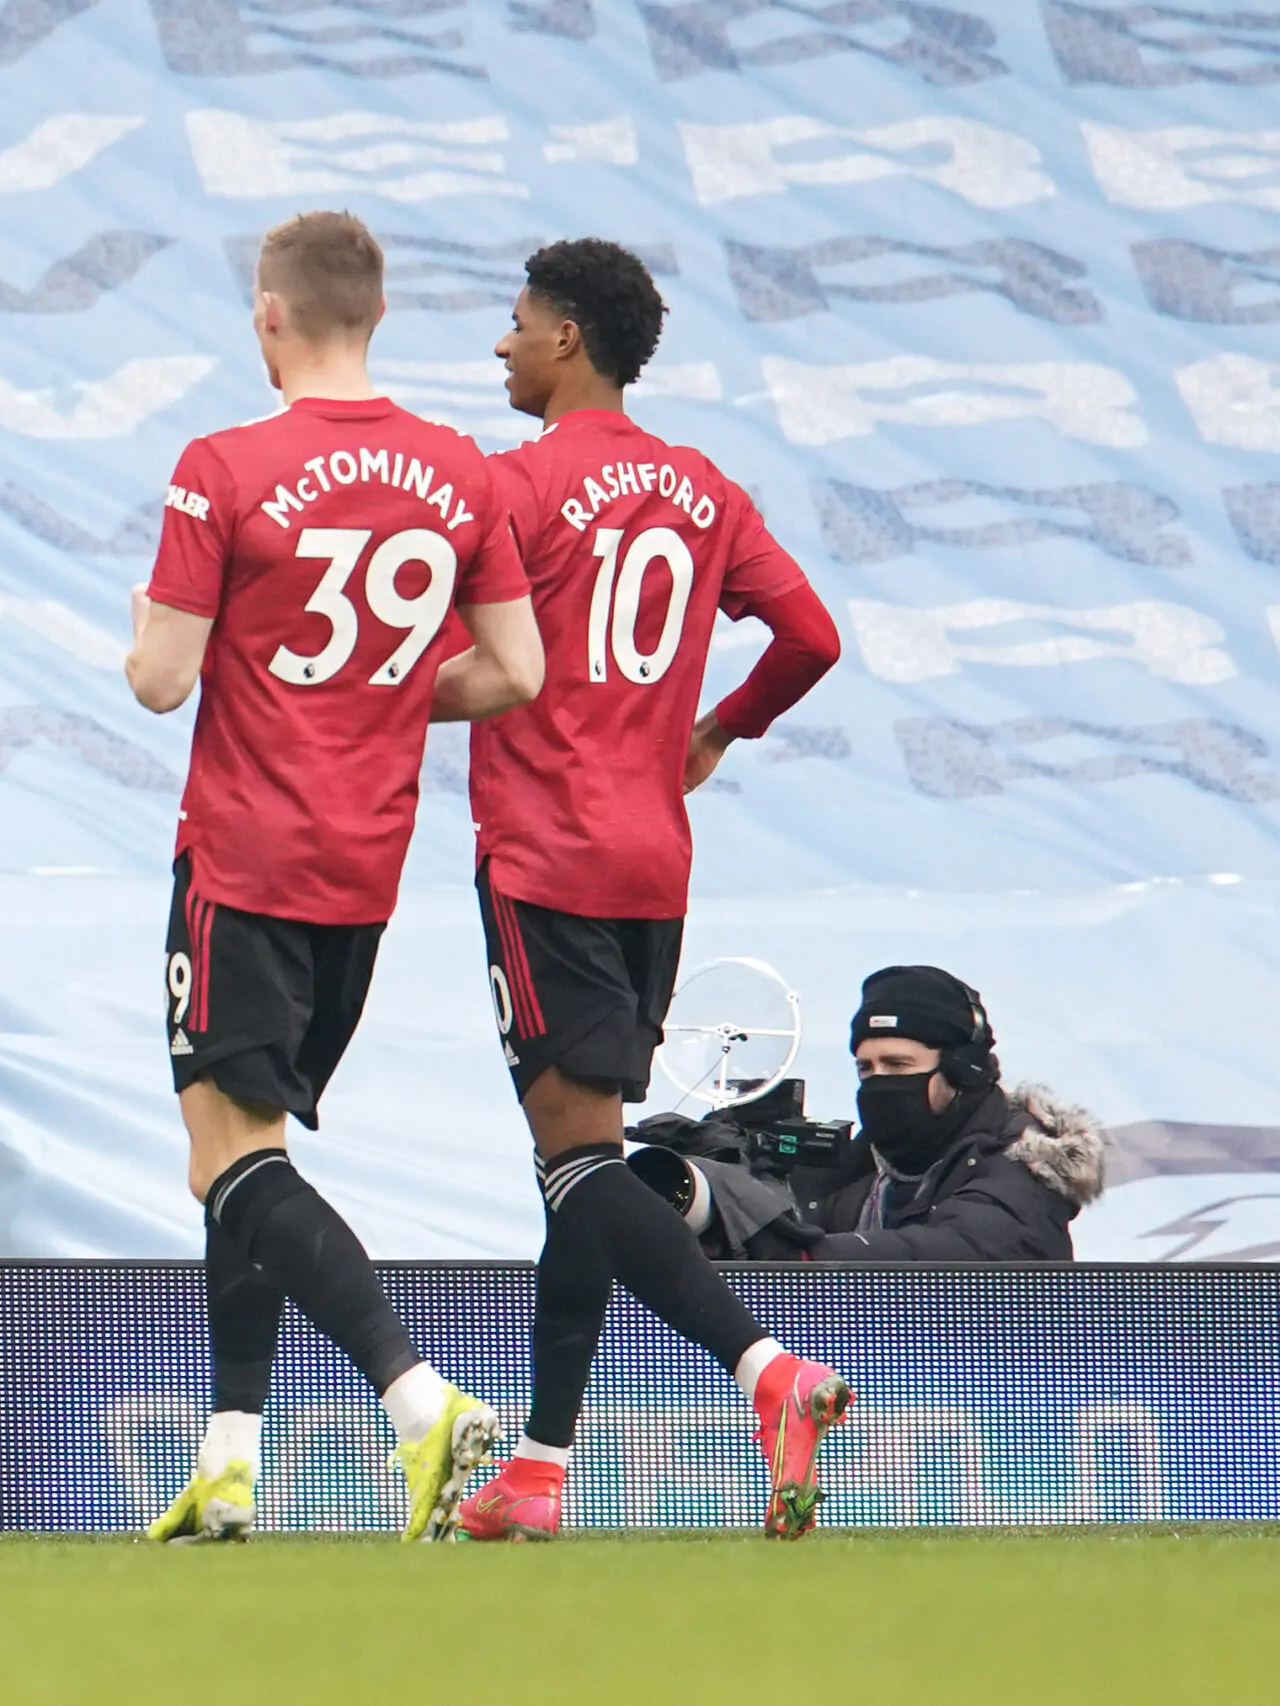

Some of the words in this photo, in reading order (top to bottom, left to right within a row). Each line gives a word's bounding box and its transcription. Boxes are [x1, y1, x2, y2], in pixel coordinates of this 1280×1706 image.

[164, 484, 211, 522] HLER
[261, 447, 475, 531] McTOMINAY
[560, 461, 716, 530] RASHFORD
[268, 527, 458, 686] 39
[587, 526, 695, 685] 10
[166, 951, 193, 1024] 9
